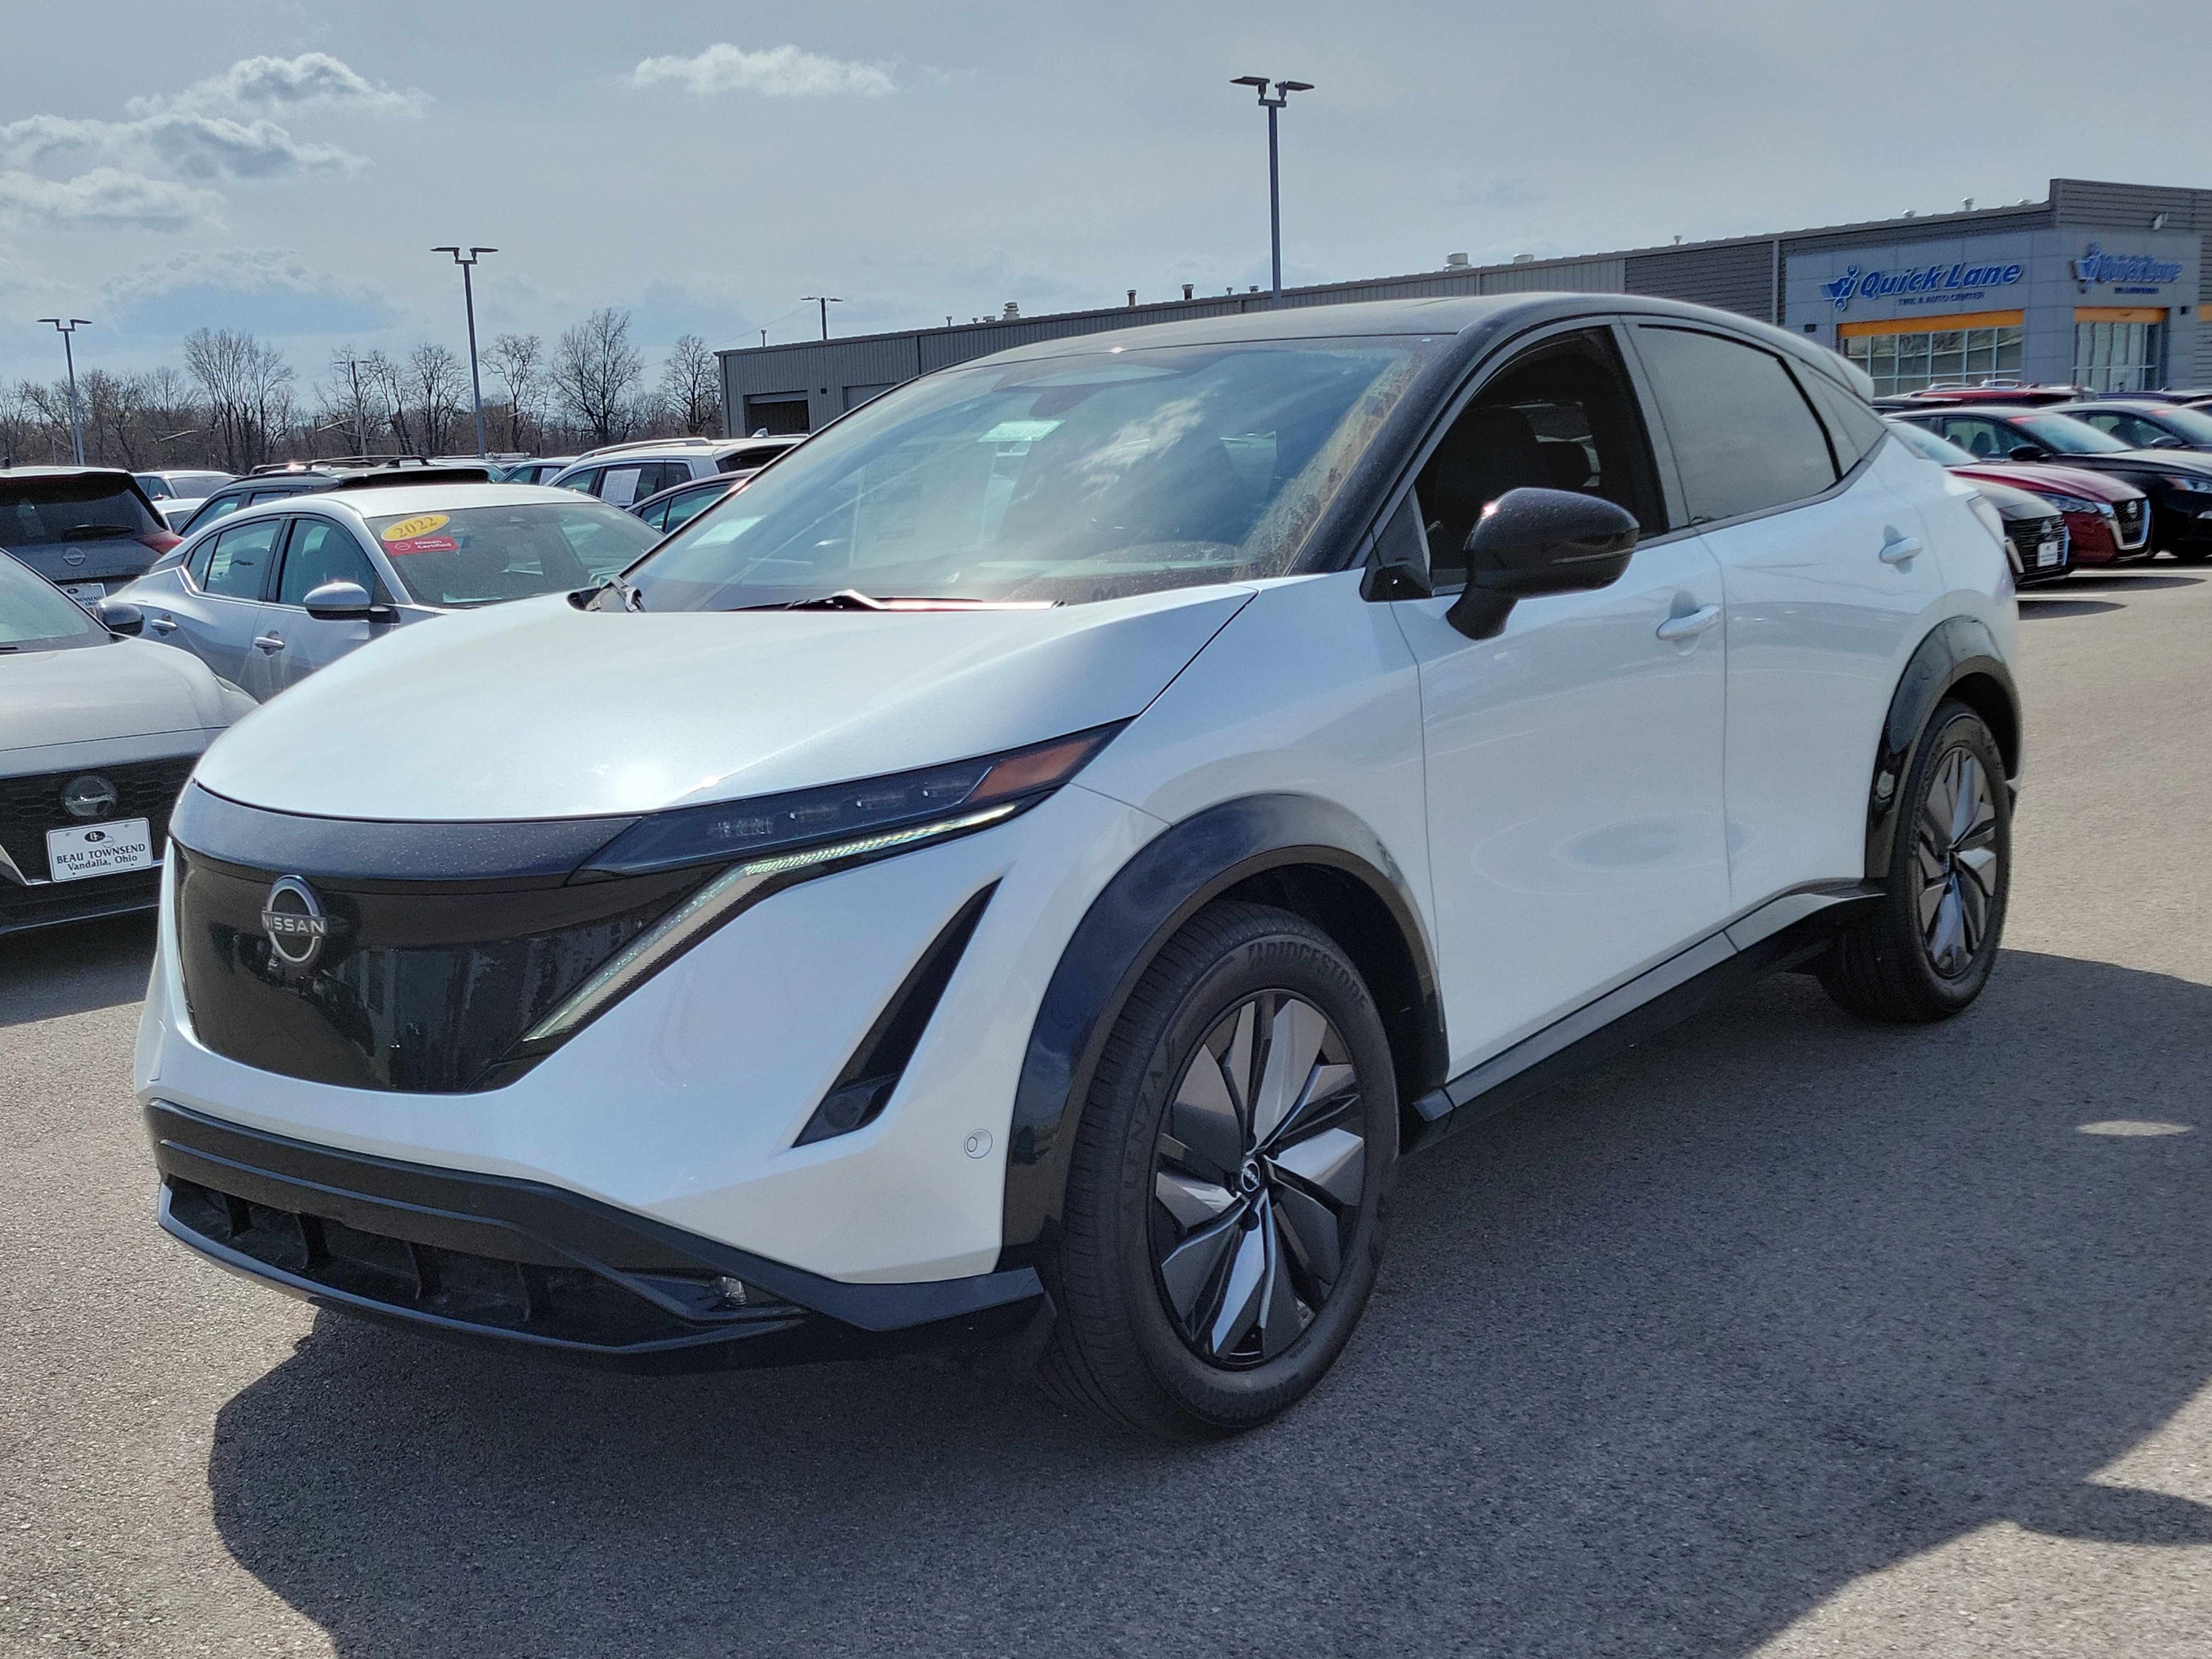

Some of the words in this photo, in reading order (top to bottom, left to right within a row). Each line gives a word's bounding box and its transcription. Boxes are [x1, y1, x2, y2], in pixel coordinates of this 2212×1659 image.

[1860, 264, 1948, 300] Quick
[1944, 262, 2023, 290] Lane
[1926, 294, 1949, 303] AUTO
[394, 517, 437, 537] 2022
[56, 852, 84, 864] BEAU
[88, 843, 146, 859] TOWNSEND
[115, 854, 137, 864] Ohio
[262, 913, 325, 934] NISSAN
